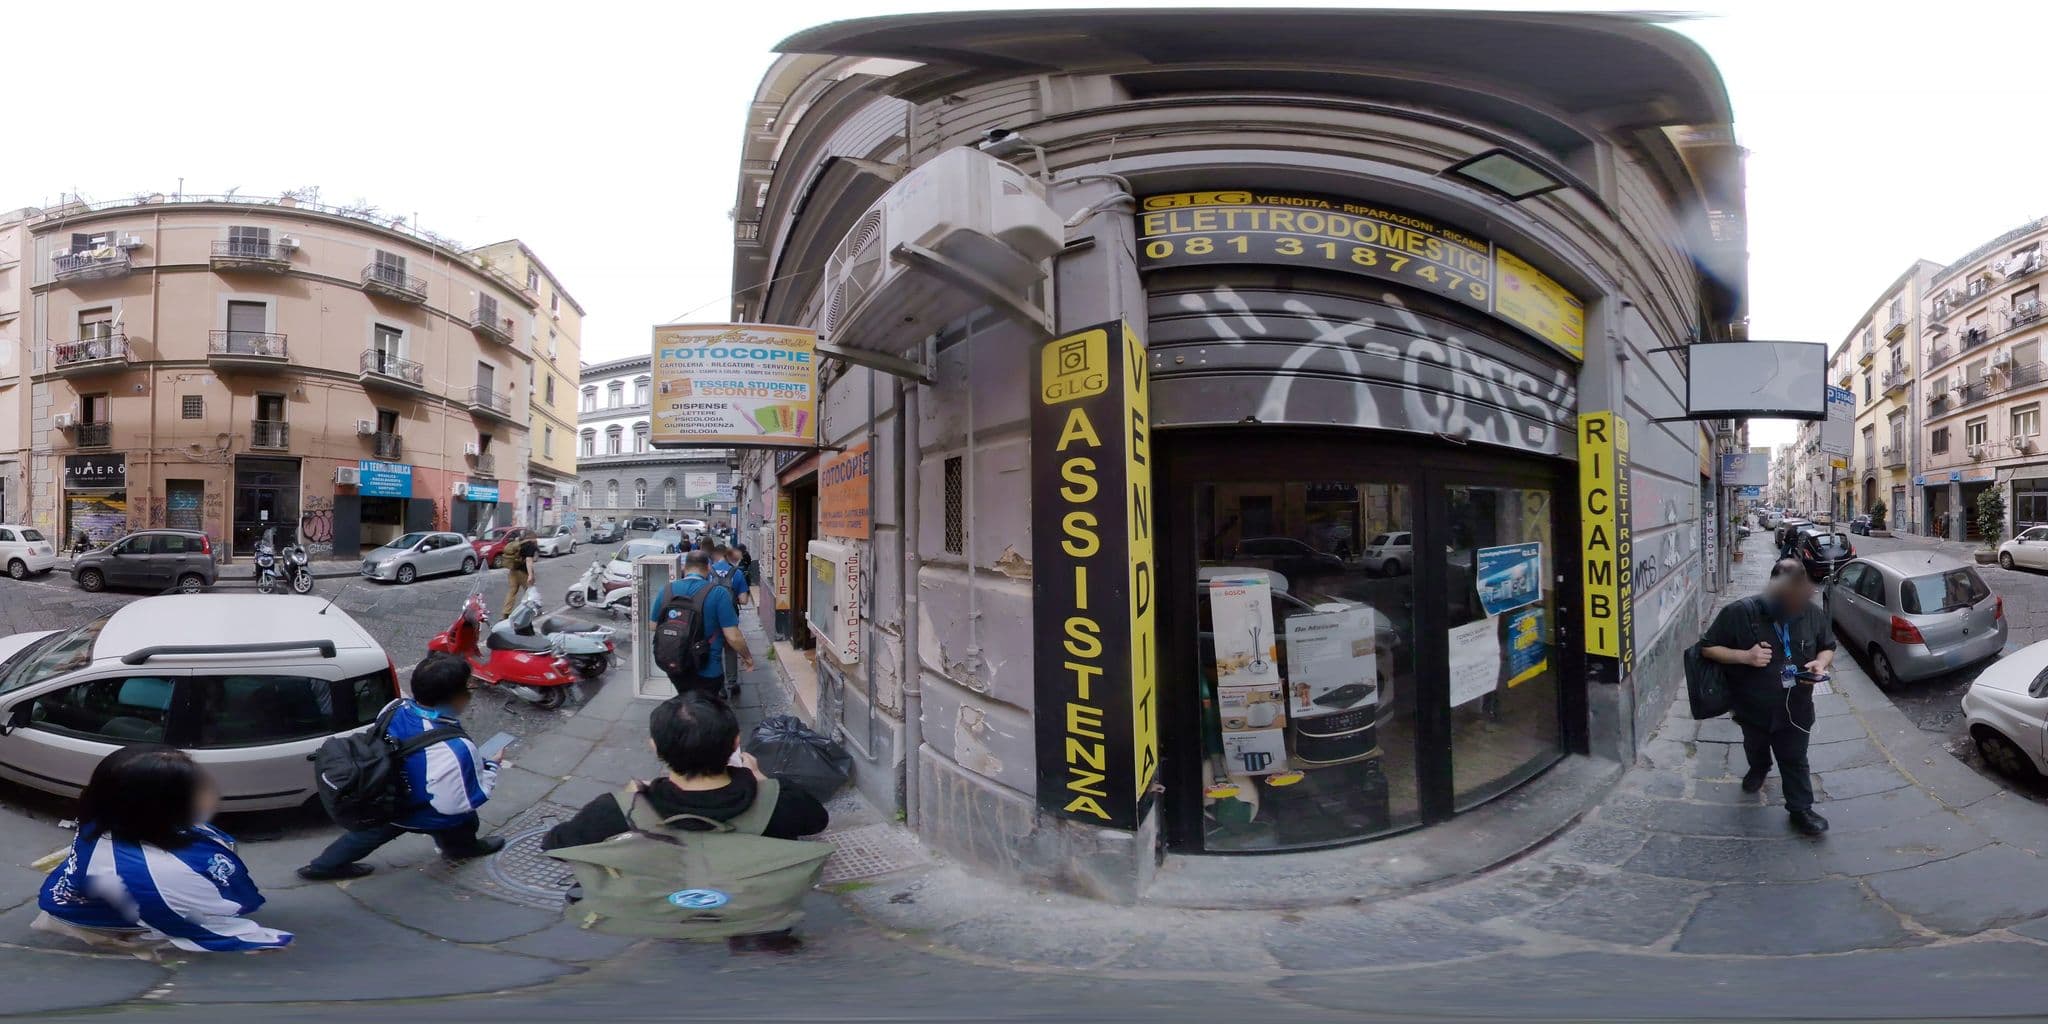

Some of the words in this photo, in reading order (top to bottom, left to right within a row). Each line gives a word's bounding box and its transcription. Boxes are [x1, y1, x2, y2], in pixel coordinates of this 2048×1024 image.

[1144, 208, 1488, 280] ELETTRODOMESTICI
[1256, 195, 1330, 208] VENDITA
[1343, 203, 1434, 232] RIPARAZIONI
[1443, 230, 1489, 254] RICAMBI
[1145, 235, 1248, 259] 081
[1274, 237, 1487, 301] 3187479
[660, 347, 810, 363] FOTOCOPIE
[694, 380, 741, 389] TESSERA
[747, 381, 807, 392] STUDENTE
[1045, 372, 1105, 401] GLG
[702, 388, 769, 397] SCONTO
[773, 389, 807, 400] 20%
[361, 461, 369, 471] LA
[822, 450, 870, 489] FOTOCOPIE
[779, 515, 789, 595] FOTOCOPIE
[1128, 338, 1154, 789] VENDITA
[1586, 418, 1612, 651] RICAMBI
[1618, 452, 1632, 673] ELETTRODOMESTICI
[1705, 501, 1715, 573] FOTOCOPIE
[847, 556, 858, 626] SERVIZIO
[1055, 406, 1112, 821] ASSISTENZA
[847, 632, 858, 655] FAX
